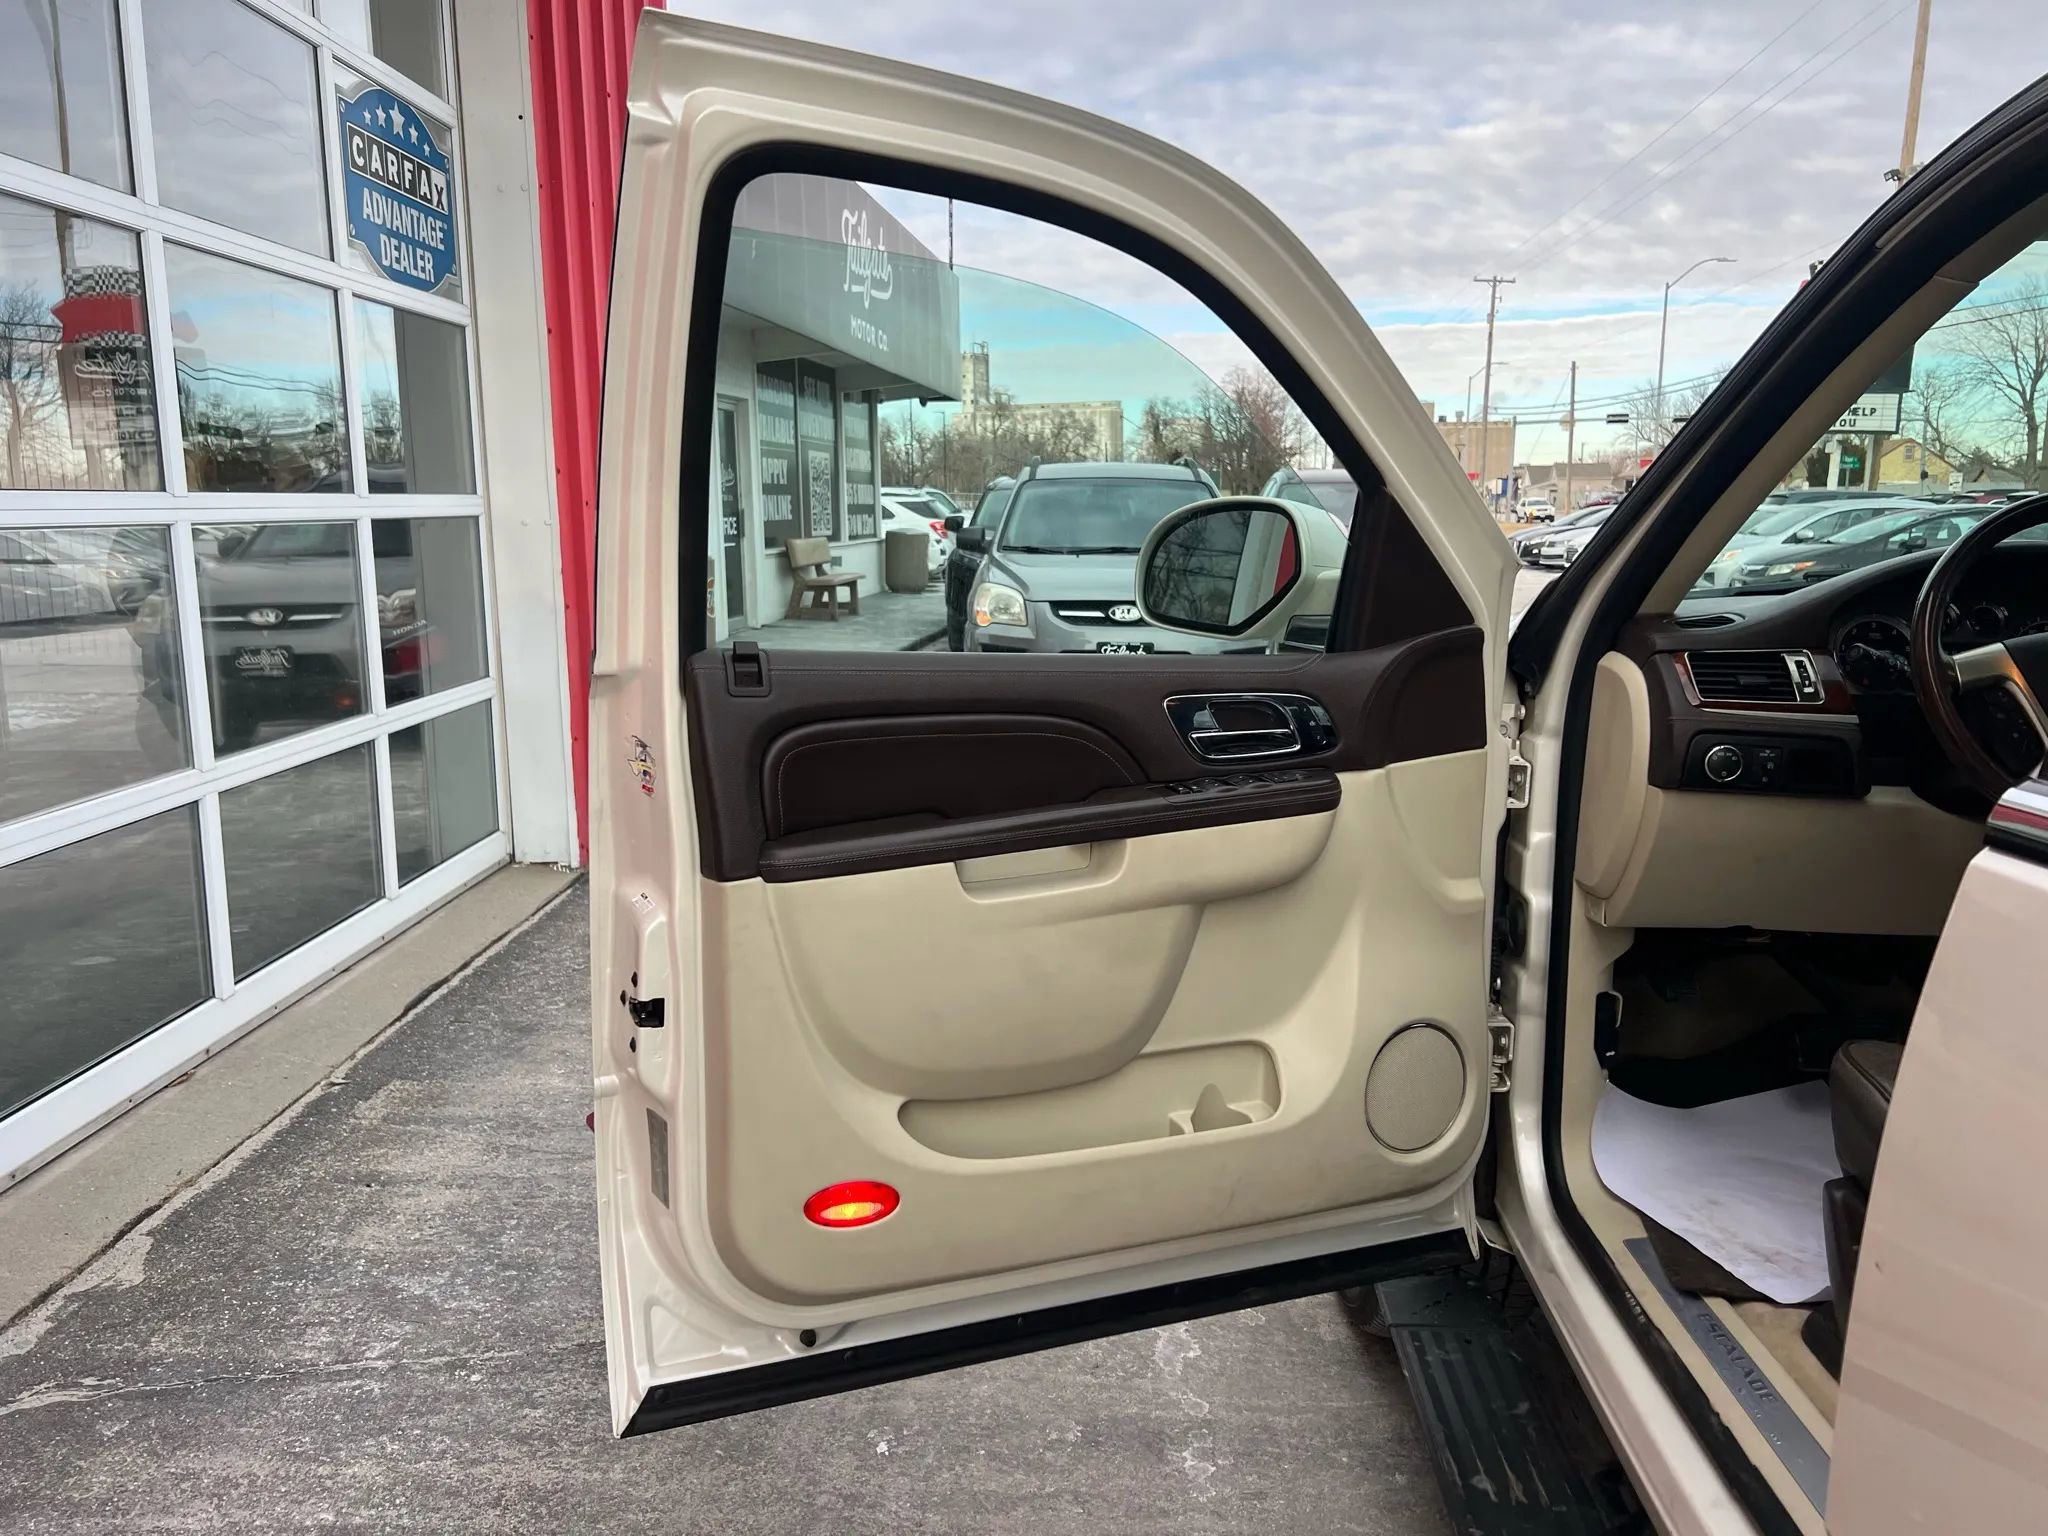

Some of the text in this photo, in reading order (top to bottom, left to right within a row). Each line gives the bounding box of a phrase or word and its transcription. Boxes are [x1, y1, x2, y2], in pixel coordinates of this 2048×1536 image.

[352, 133, 446, 212] CARFAX
[362, 187, 446, 251] ADVANTAGE
[380, 232, 435, 283] DEALER
[850, 314, 877, 347] MOTOR
[1847, 407, 1877, 417] HELP
[762, 457, 788, 485] APPLY
[762, 494, 793, 522] ONLINE
[391, 618, 427, 636] HONDA
